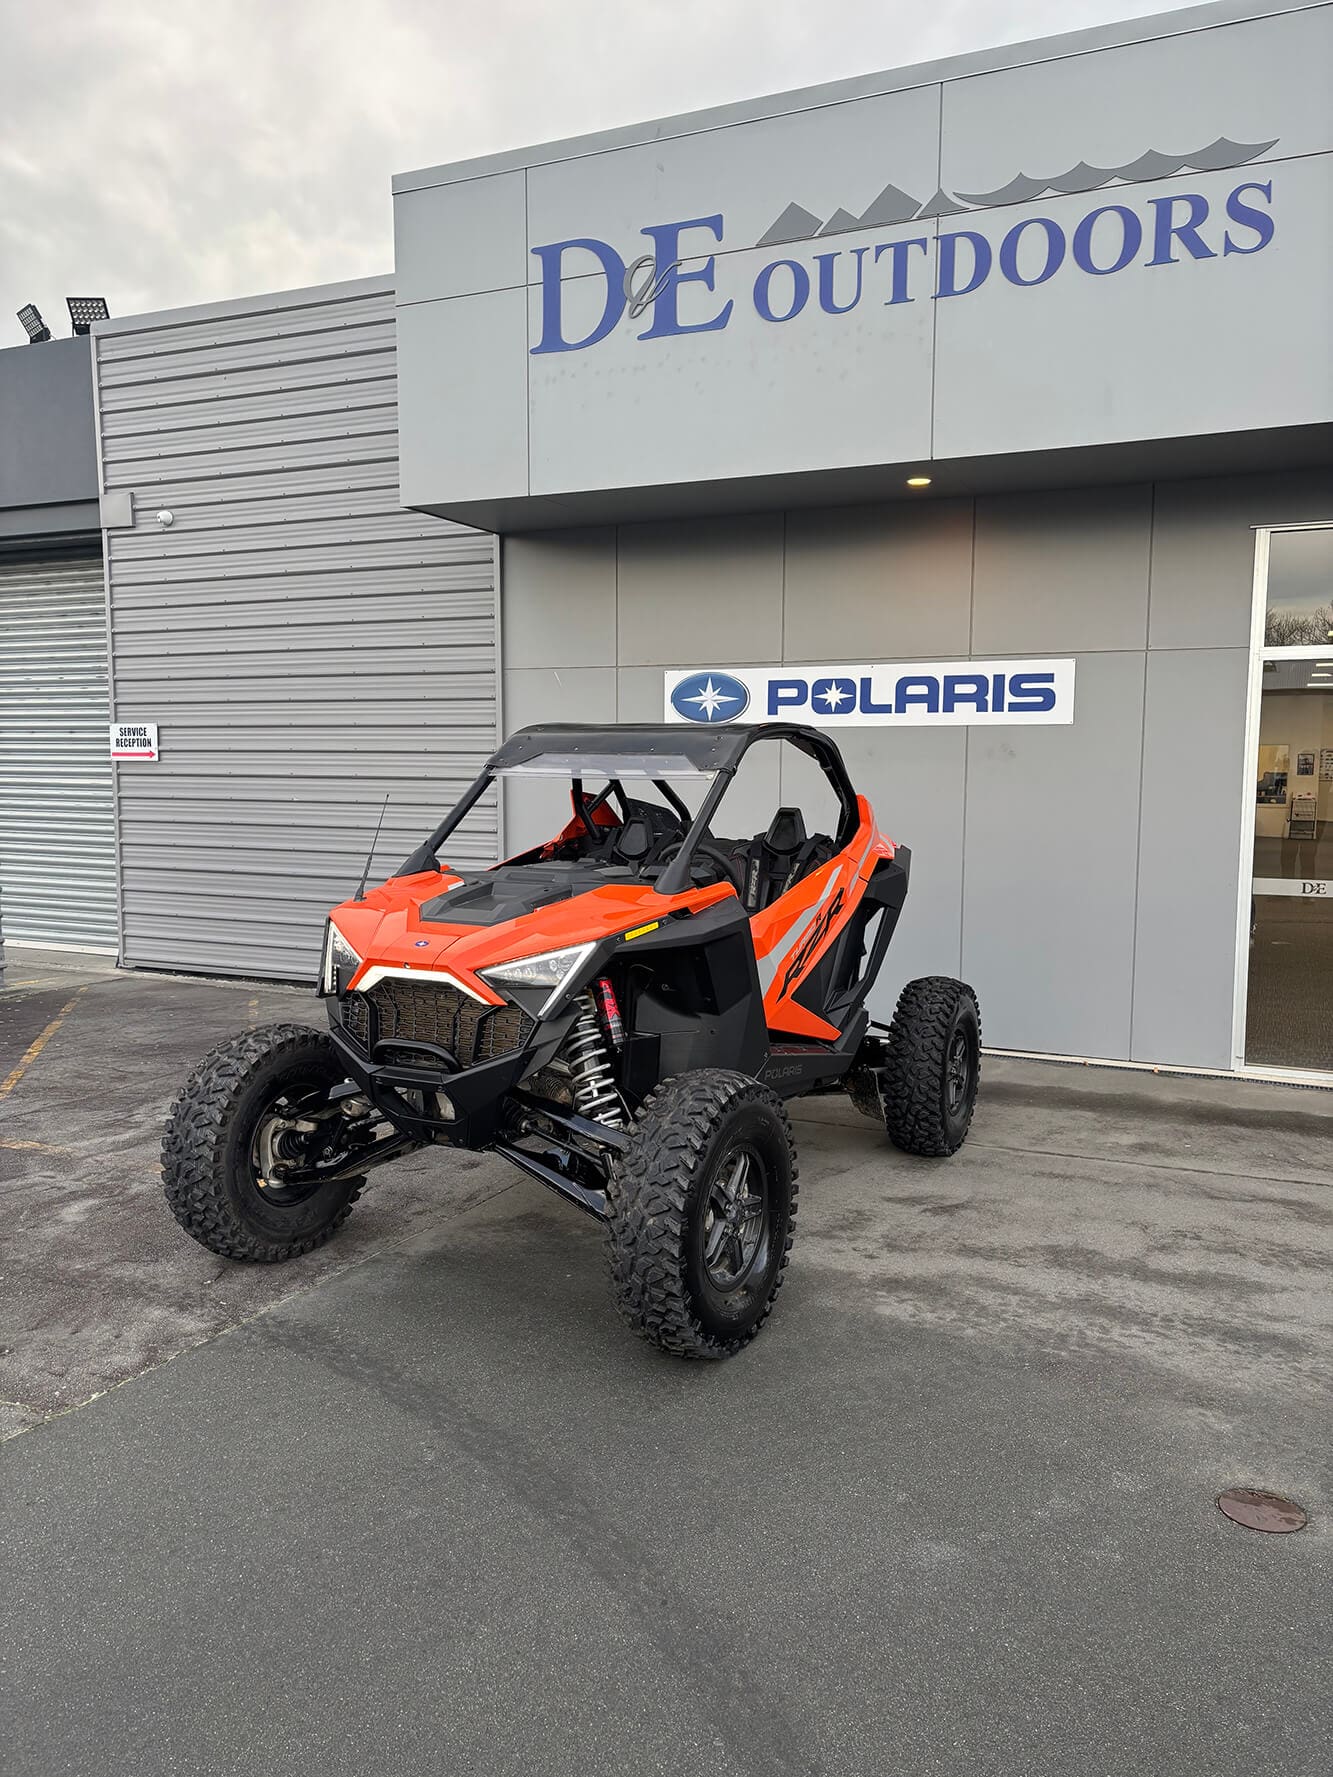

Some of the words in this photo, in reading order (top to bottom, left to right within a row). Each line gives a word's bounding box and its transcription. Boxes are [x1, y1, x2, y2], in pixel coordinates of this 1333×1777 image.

[752, 179, 1276, 324] OUTDOORS
[767, 672, 1056, 716] POLARIS
[115, 738, 152, 748] RECEPTION
[119, 727, 147, 737] SERVICE
